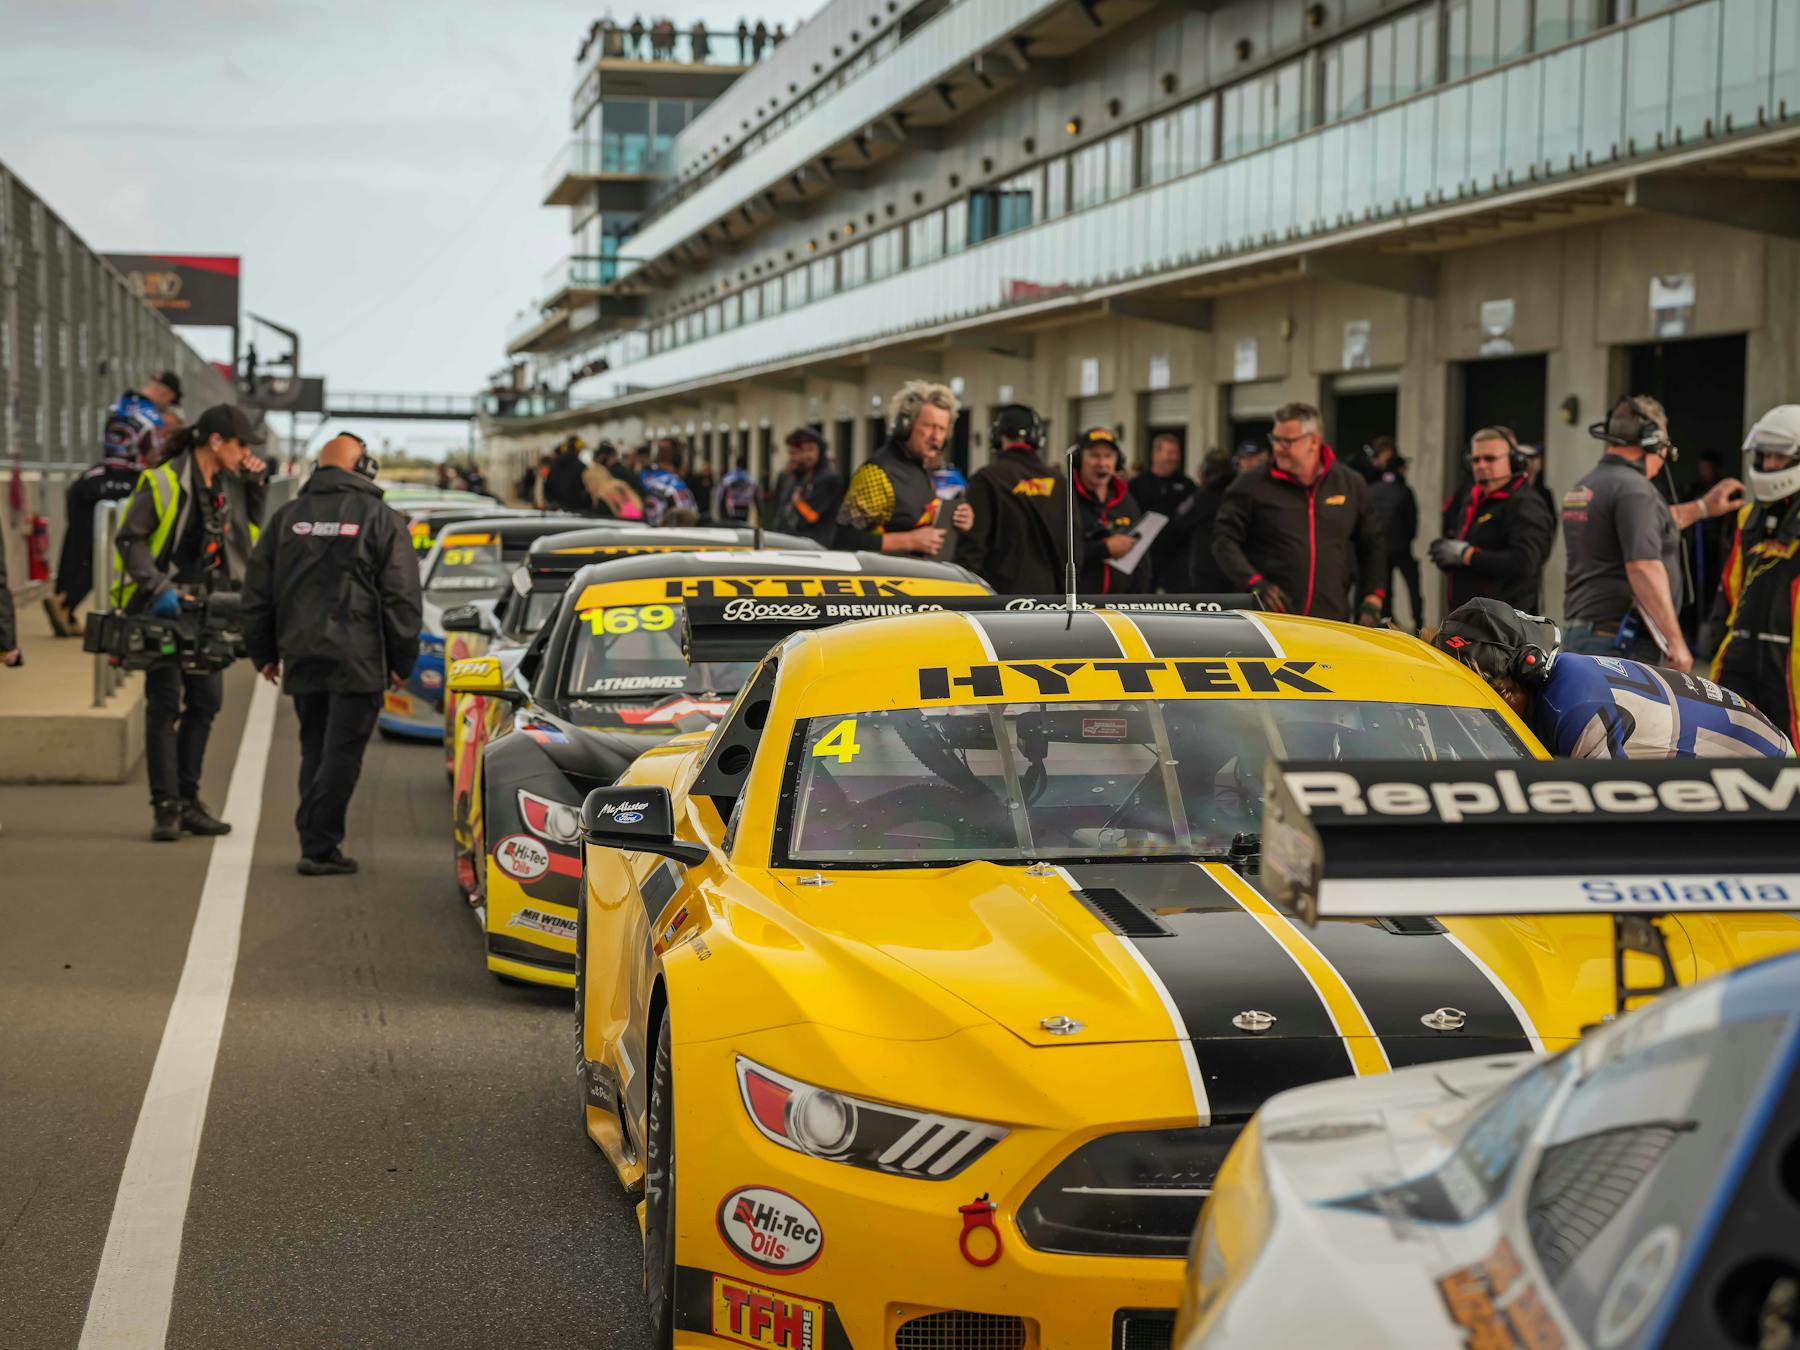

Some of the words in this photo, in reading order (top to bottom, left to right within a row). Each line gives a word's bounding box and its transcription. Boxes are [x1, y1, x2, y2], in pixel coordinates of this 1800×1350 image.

[666, 580, 911, 598] HYTEK
[722, 599, 820, 621] Boxer
[826, 604, 913, 616] BREWING
[1005, 599, 1096, 611] Boxr
[579, 605, 675, 636] 169
[586, 676, 687, 692] J.THOMAS
[919, 661, 1335, 700] HYTEK
[812, 719, 860, 763] 4
[512, 860, 531, 874] Oils
[515, 844, 547, 865] Hi-Tec
[1581, 878, 1789, 904] Salafia
[520, 908, 540, 922] MR
[541, 913, 578, 931] WONG
[754, 1203, 818, 1244] Hi-Tec
[751, 1231, 786, 1260] Oils
[722, 1283, 806, 1349] TFH
[802, 1310, 813, 1350] HIRE
